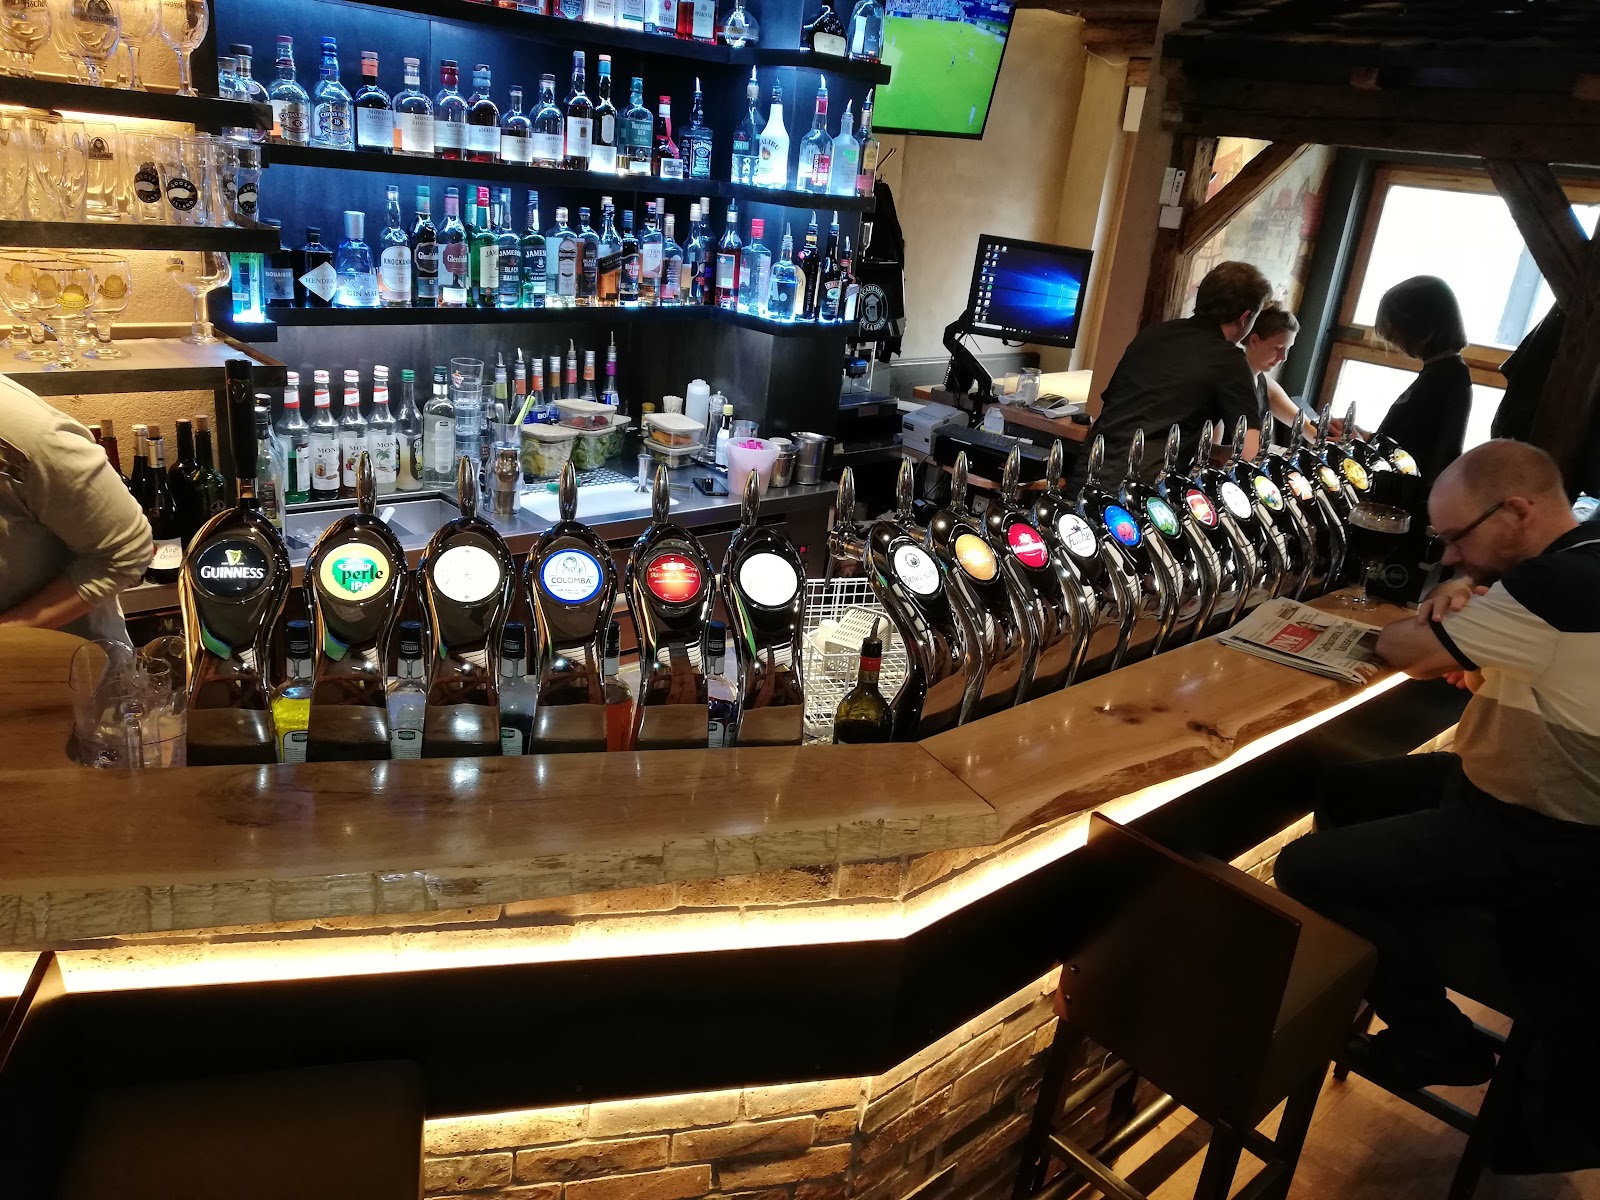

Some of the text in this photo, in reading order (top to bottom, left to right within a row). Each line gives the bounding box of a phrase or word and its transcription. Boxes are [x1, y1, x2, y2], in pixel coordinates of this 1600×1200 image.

[171, 181, 192, 191] GOOSE
[172, 199, 194, 211] ISLAND
[525, 250, 546, 258] JAMES
[1066, 529, 1095, 549] Fischer
[200, 565, 265, 579] GUINNESS
[342, 564, 384, 586] perle
[350, 581, 370, 591] IPA
[551, 576, 592, 585] COLOMBA
